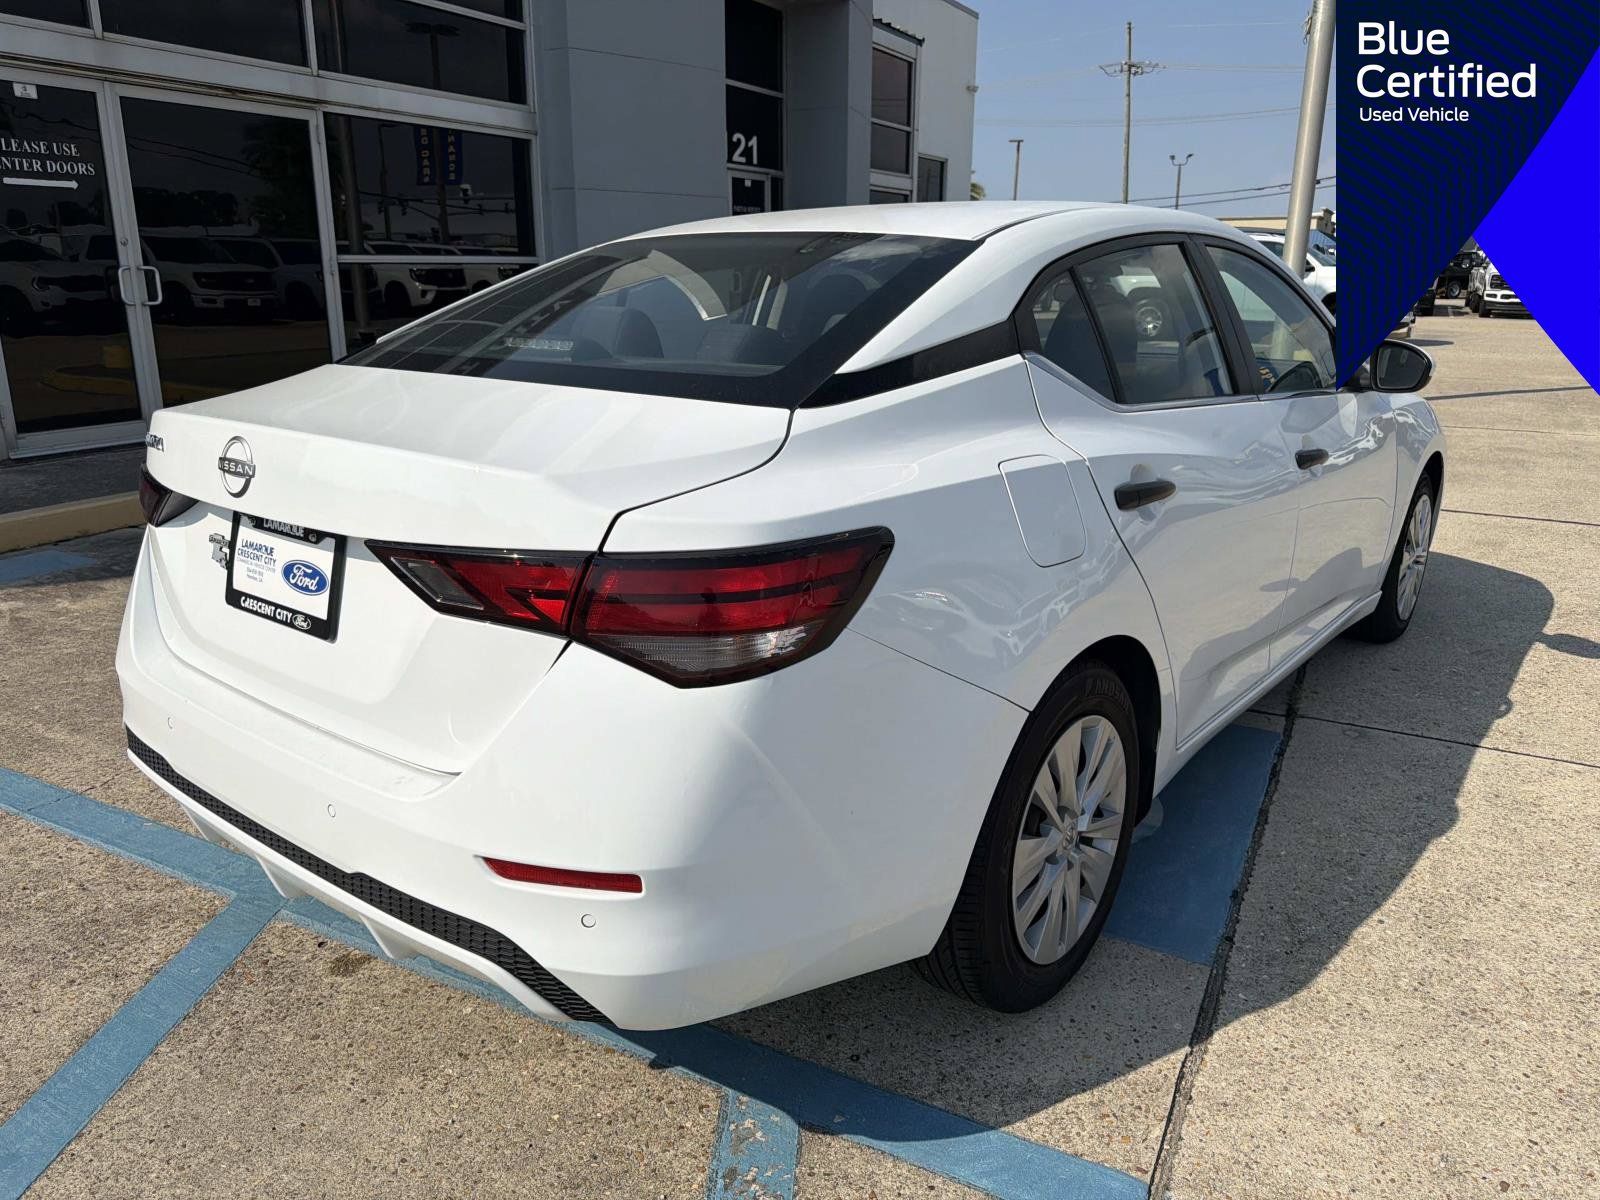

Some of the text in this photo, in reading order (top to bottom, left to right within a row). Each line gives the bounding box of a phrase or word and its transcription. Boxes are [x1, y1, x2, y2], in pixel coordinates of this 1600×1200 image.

[0, 137, 80, 157] LEASE USE
[732, 132, 758, 165] 21
[46, 160, 96, 176] DOORS
[218, 458, 254, 477] NISSAN
[263, 518, 304, 537] LAMARQUE
[237, 547, 263, 563] CRESCENT
[264, 556, 277, 567] CITY
[241, 538, 275, 557] LAMARQUE
[290, 564, 319, 591] Ford
[240, 596, 275, 617] CRESCENT
[276, 608, 293, 623] CITY
